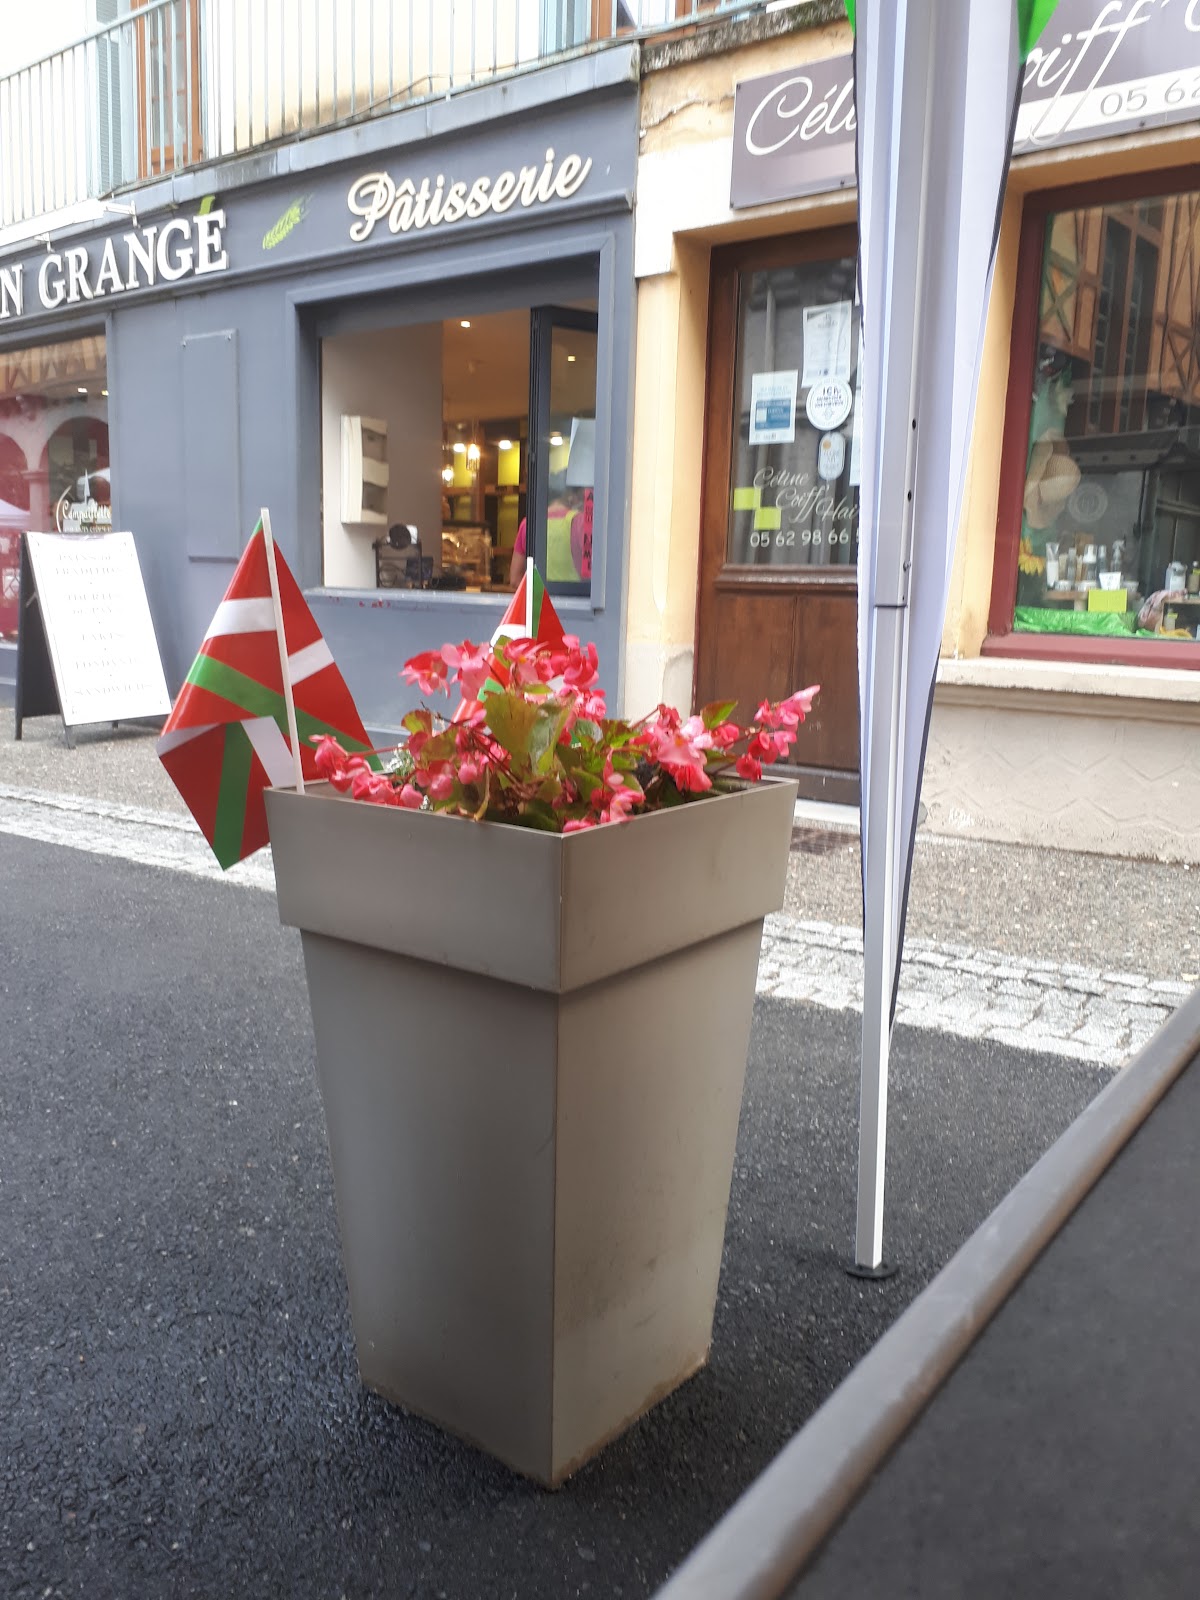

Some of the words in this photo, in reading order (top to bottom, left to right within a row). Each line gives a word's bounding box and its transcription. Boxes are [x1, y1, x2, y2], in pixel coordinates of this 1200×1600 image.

[1100, 84, 1147, 117] 05
[347, 147, 593, 242] Pâtisserie
[815, 495, 859, 521] Hai
[750, 531, 770, 547] 05
[776, 530, 795, 547] 62
[802, 529, 821, 546] 98
[828, 527, 849, 545] 66
